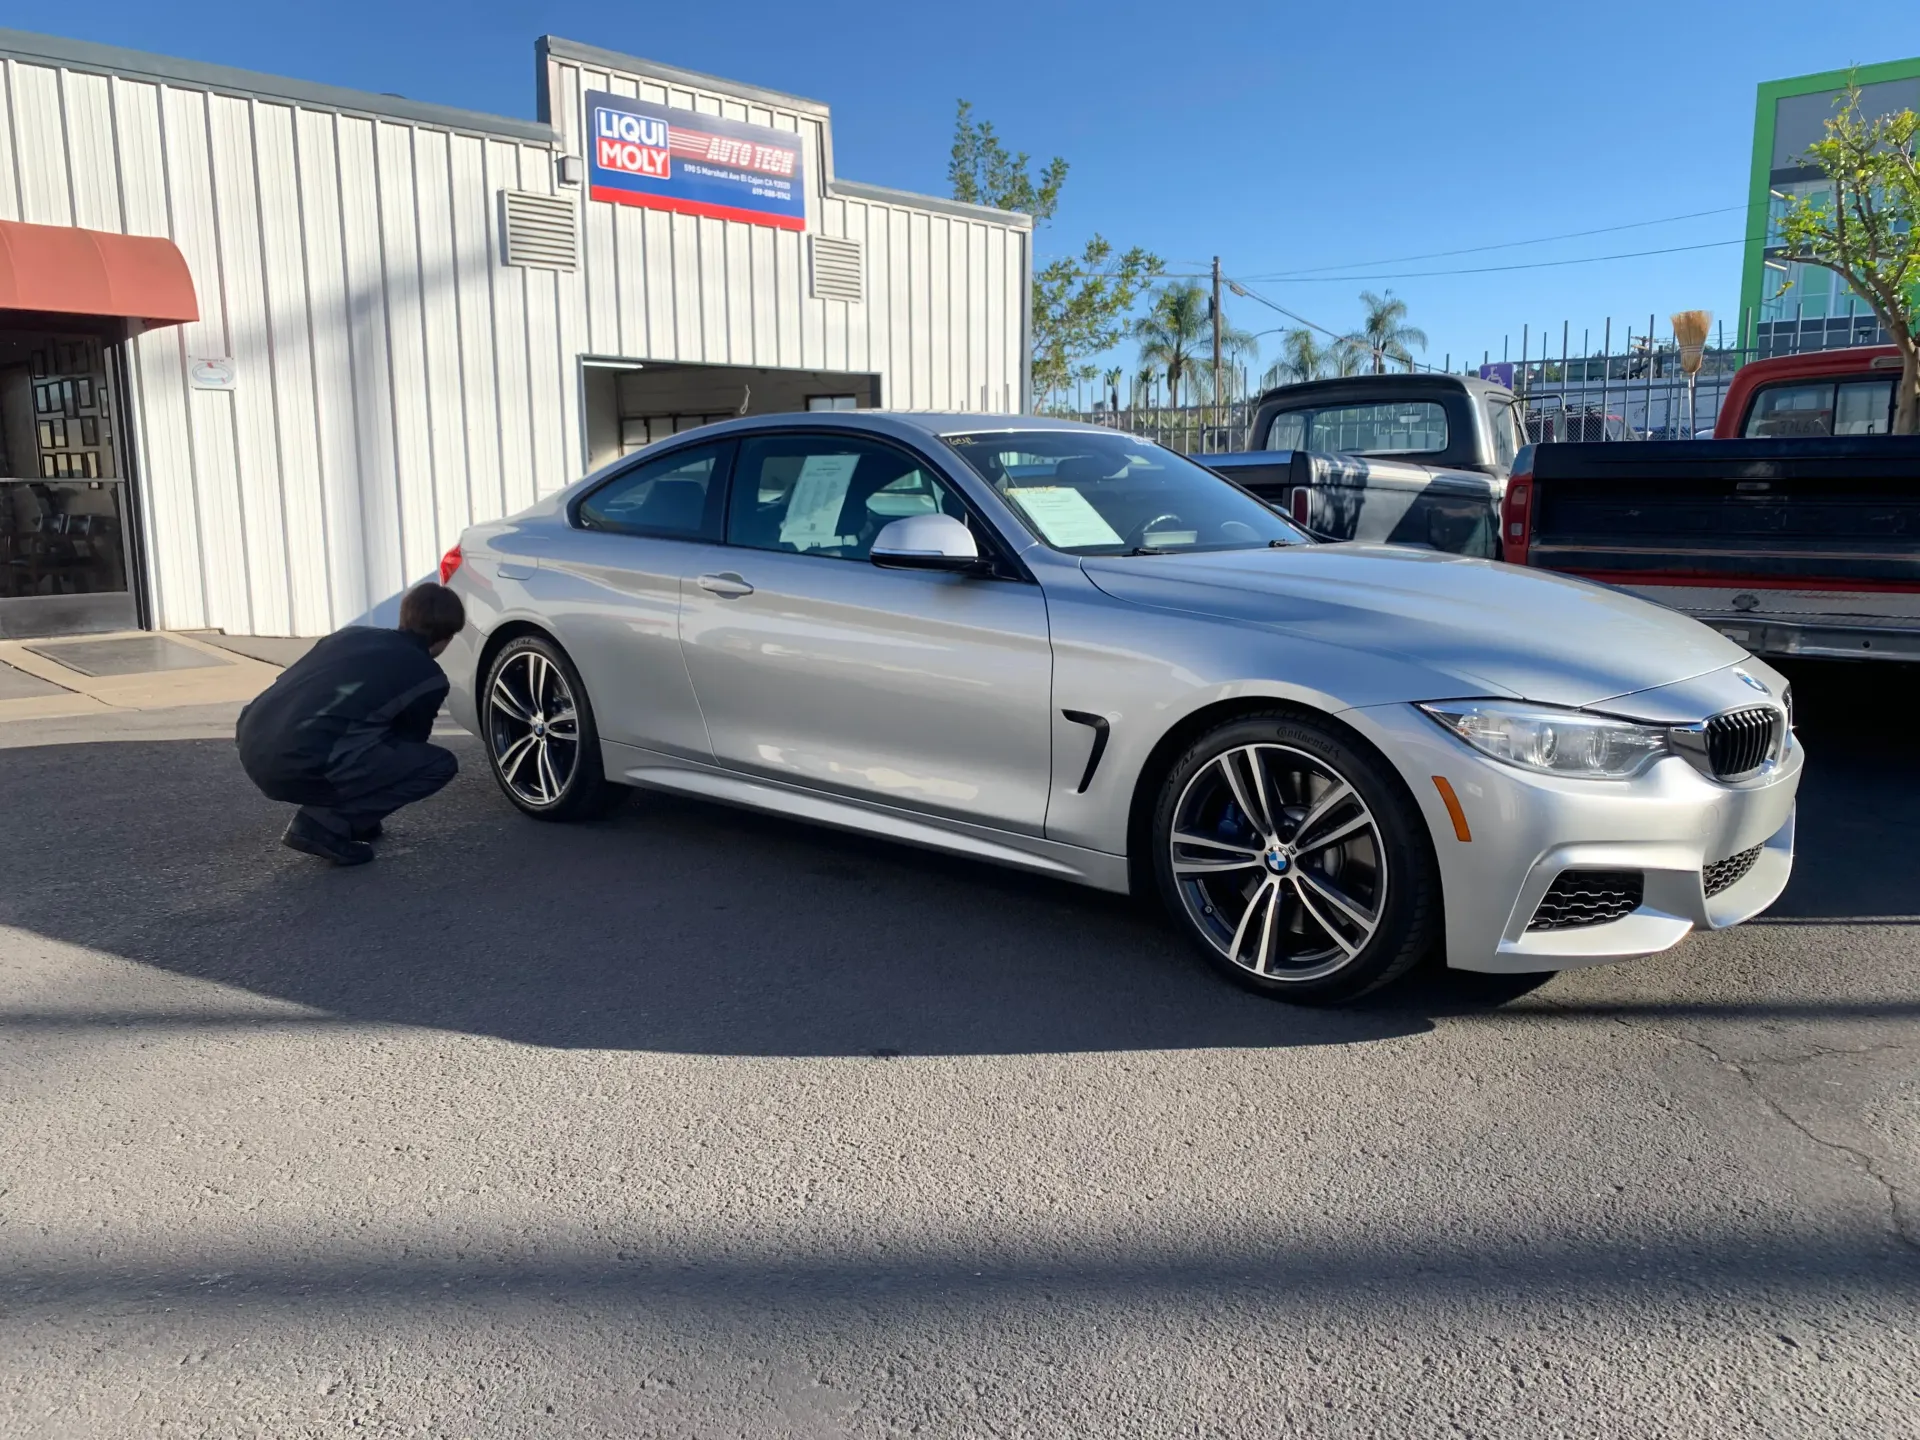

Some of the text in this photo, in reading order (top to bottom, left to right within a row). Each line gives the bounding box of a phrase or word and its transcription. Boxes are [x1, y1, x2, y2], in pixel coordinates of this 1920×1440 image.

[599, 111, 666, 148] LIQUI
[600, 141, 668, 174] MOLY
[706, 137, 795, 175] AUTO TECH
[696, 166, 702, 174] S
[702, 166, 728, 179] Marshall
[729, 172, 740, 181] Ave
[747, 175, 764, 186] Cajon
[764, 178, 774, 187] CA
